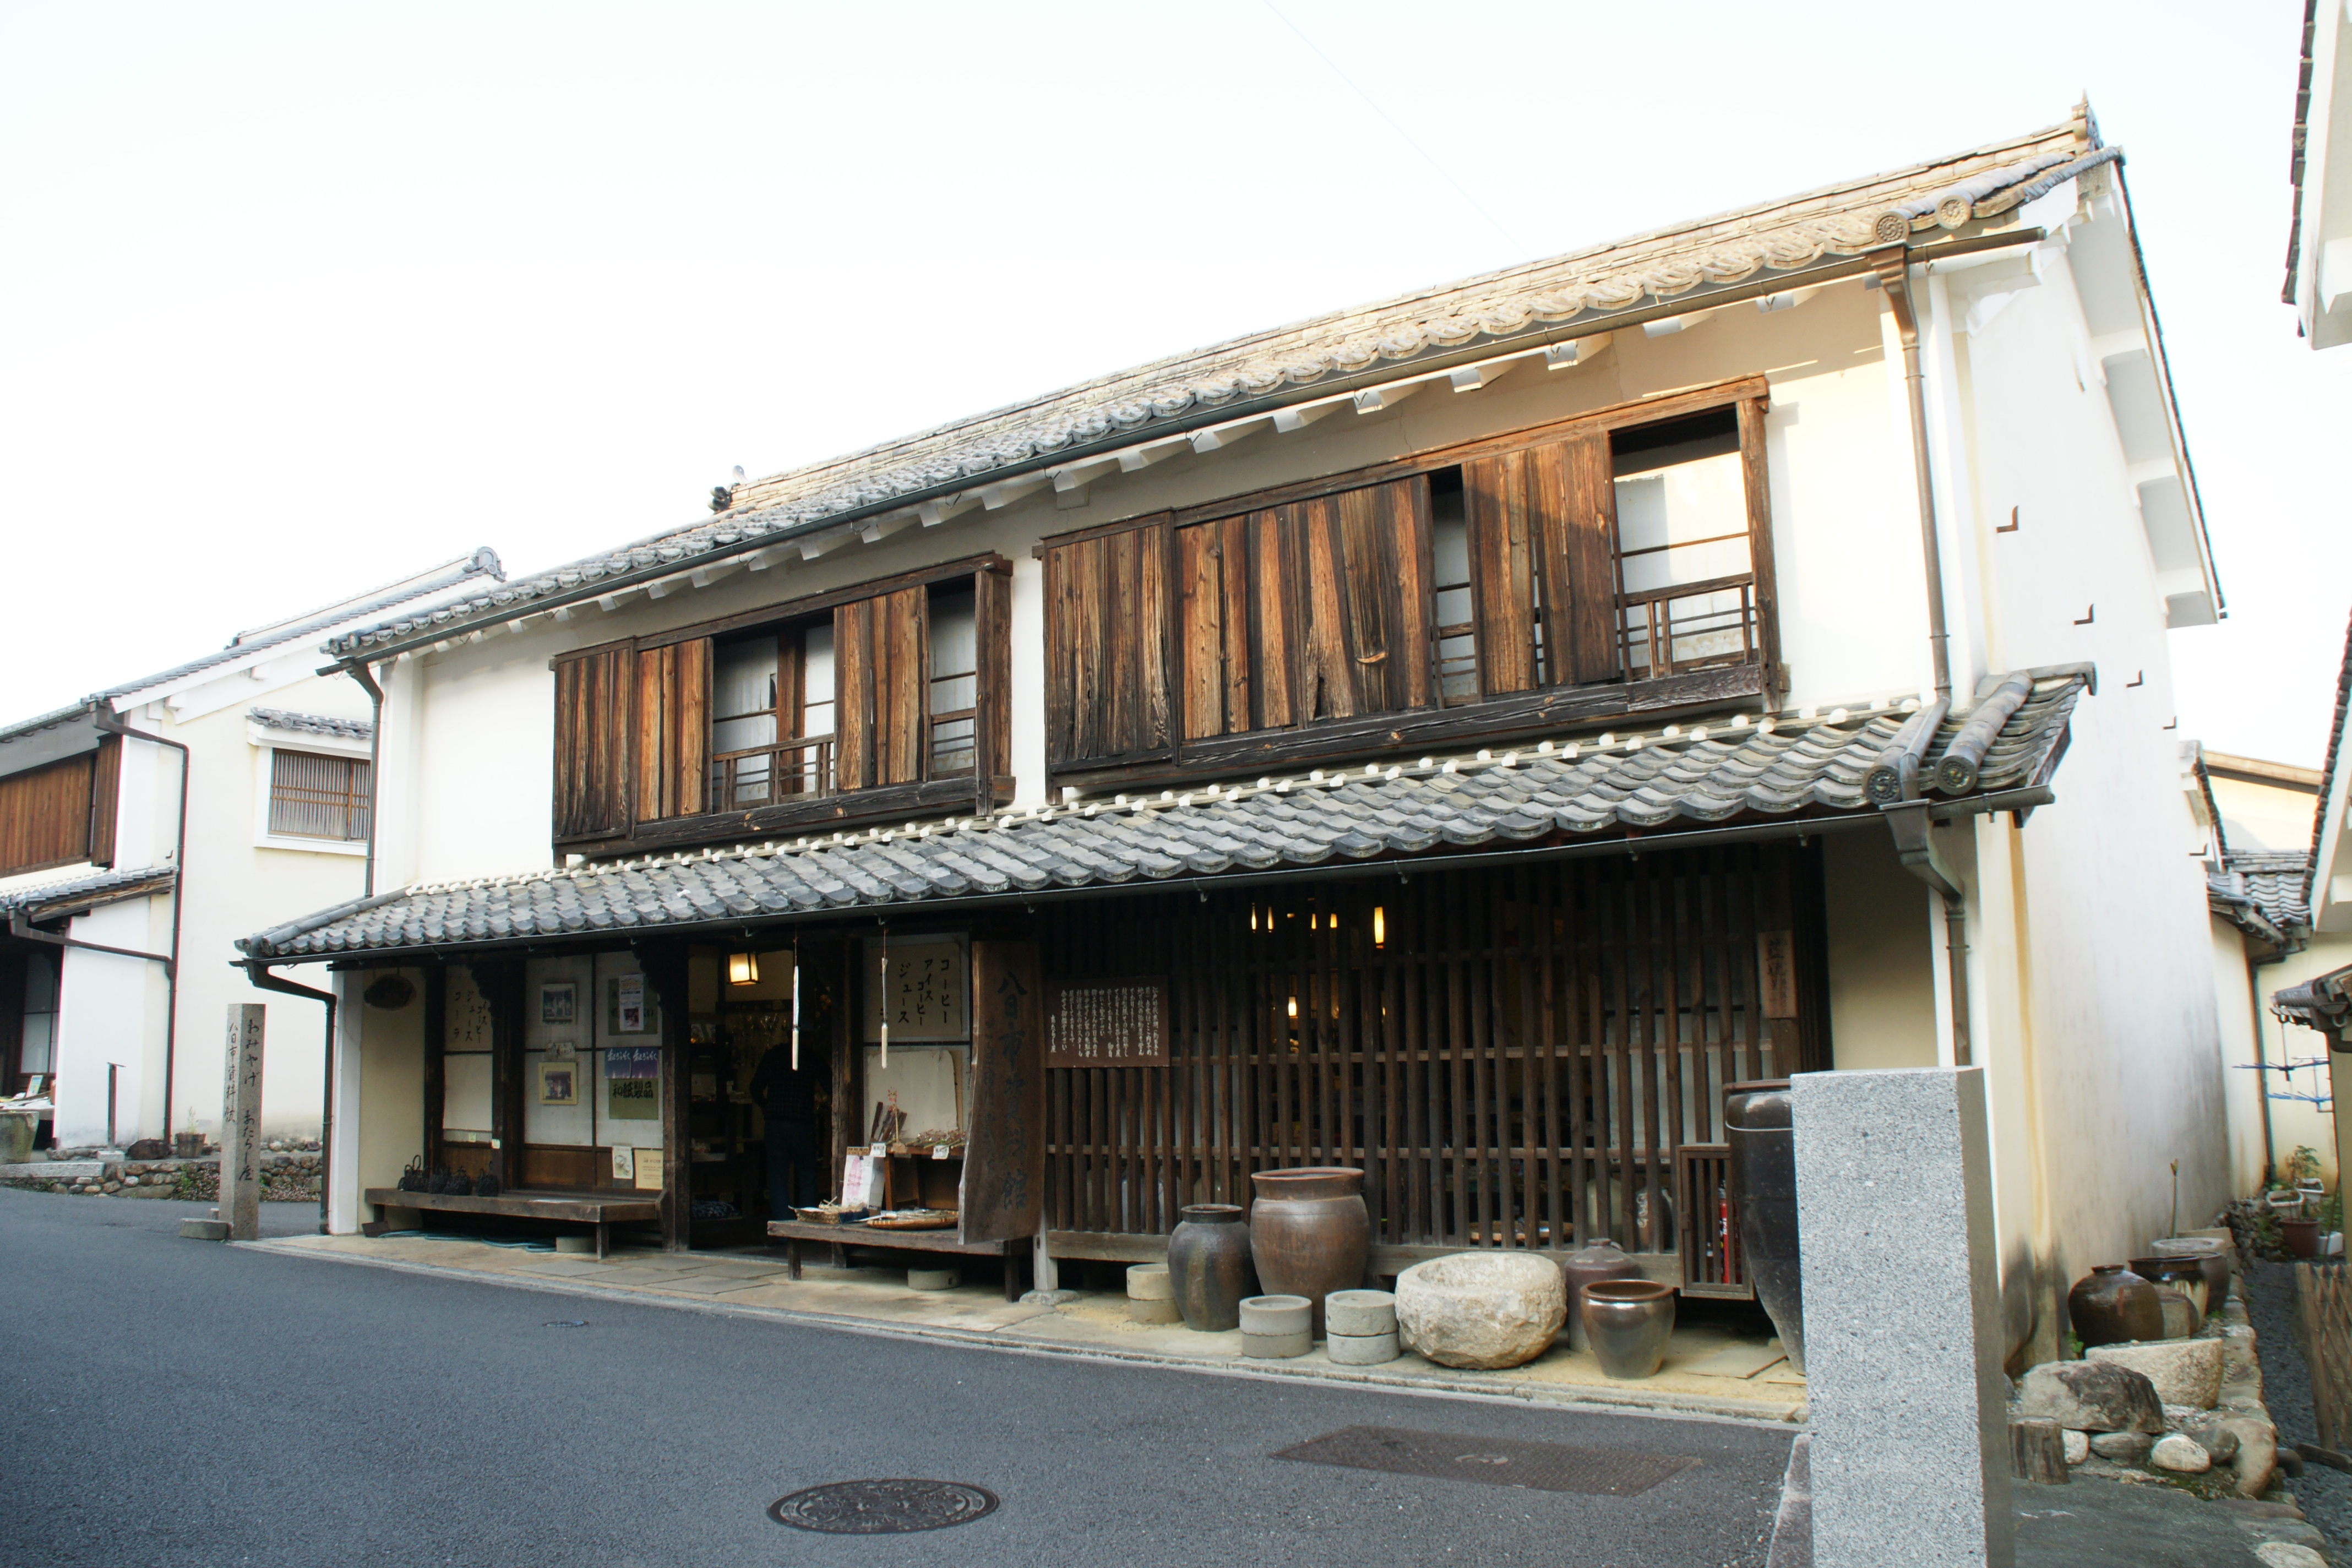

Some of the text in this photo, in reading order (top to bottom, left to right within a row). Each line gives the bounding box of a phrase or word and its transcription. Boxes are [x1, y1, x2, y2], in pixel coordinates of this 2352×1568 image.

[898, 962, 912, 1023] ジュース
[917, 959, 934, 1026] アイス コーヒー
[940, 959, 950, 1024] コーヒー
[613, 1080, 654, 1099] 和紙製品
[238, 1109, 255, 1182] あたらし屋
